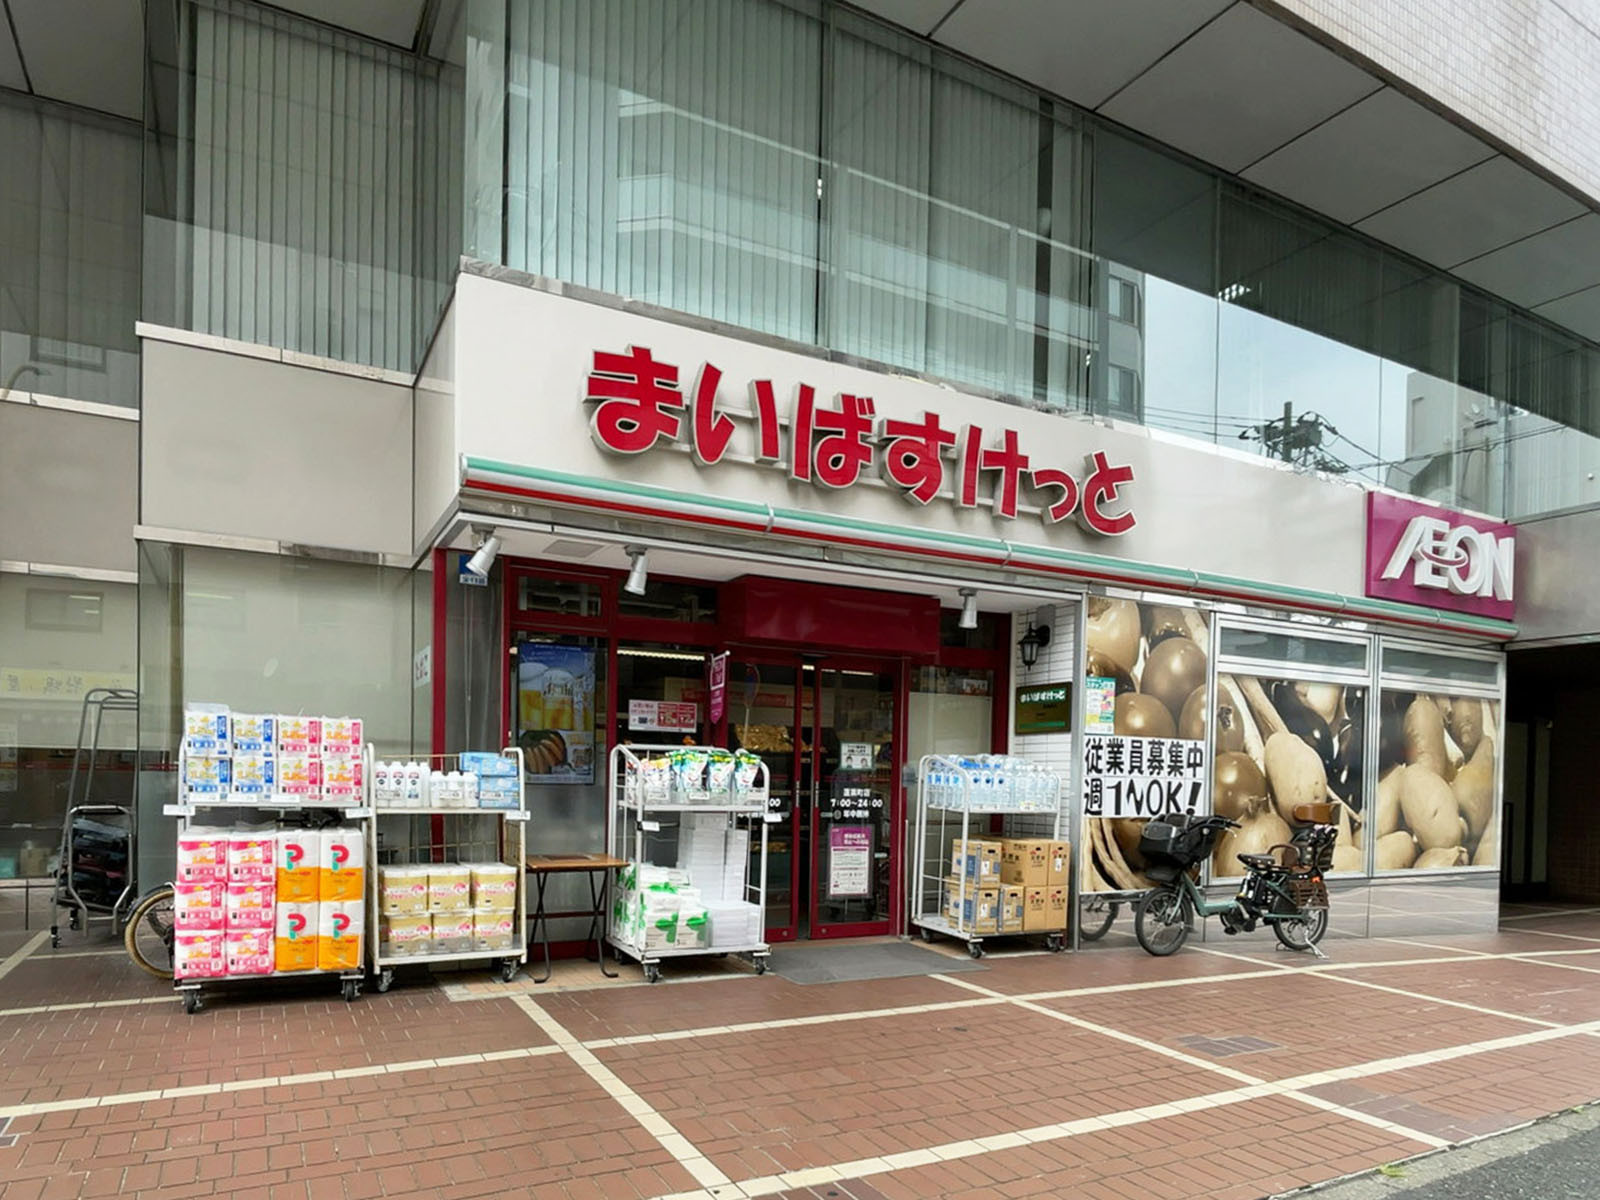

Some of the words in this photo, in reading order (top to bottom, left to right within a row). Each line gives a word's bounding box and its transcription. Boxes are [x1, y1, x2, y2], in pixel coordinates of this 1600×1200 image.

[585, 345, 1137, 537] まいばすけっと
[1381, 515, 1515, 601] AEON
[1084, 738, 1203, 778] 従業員募集中
